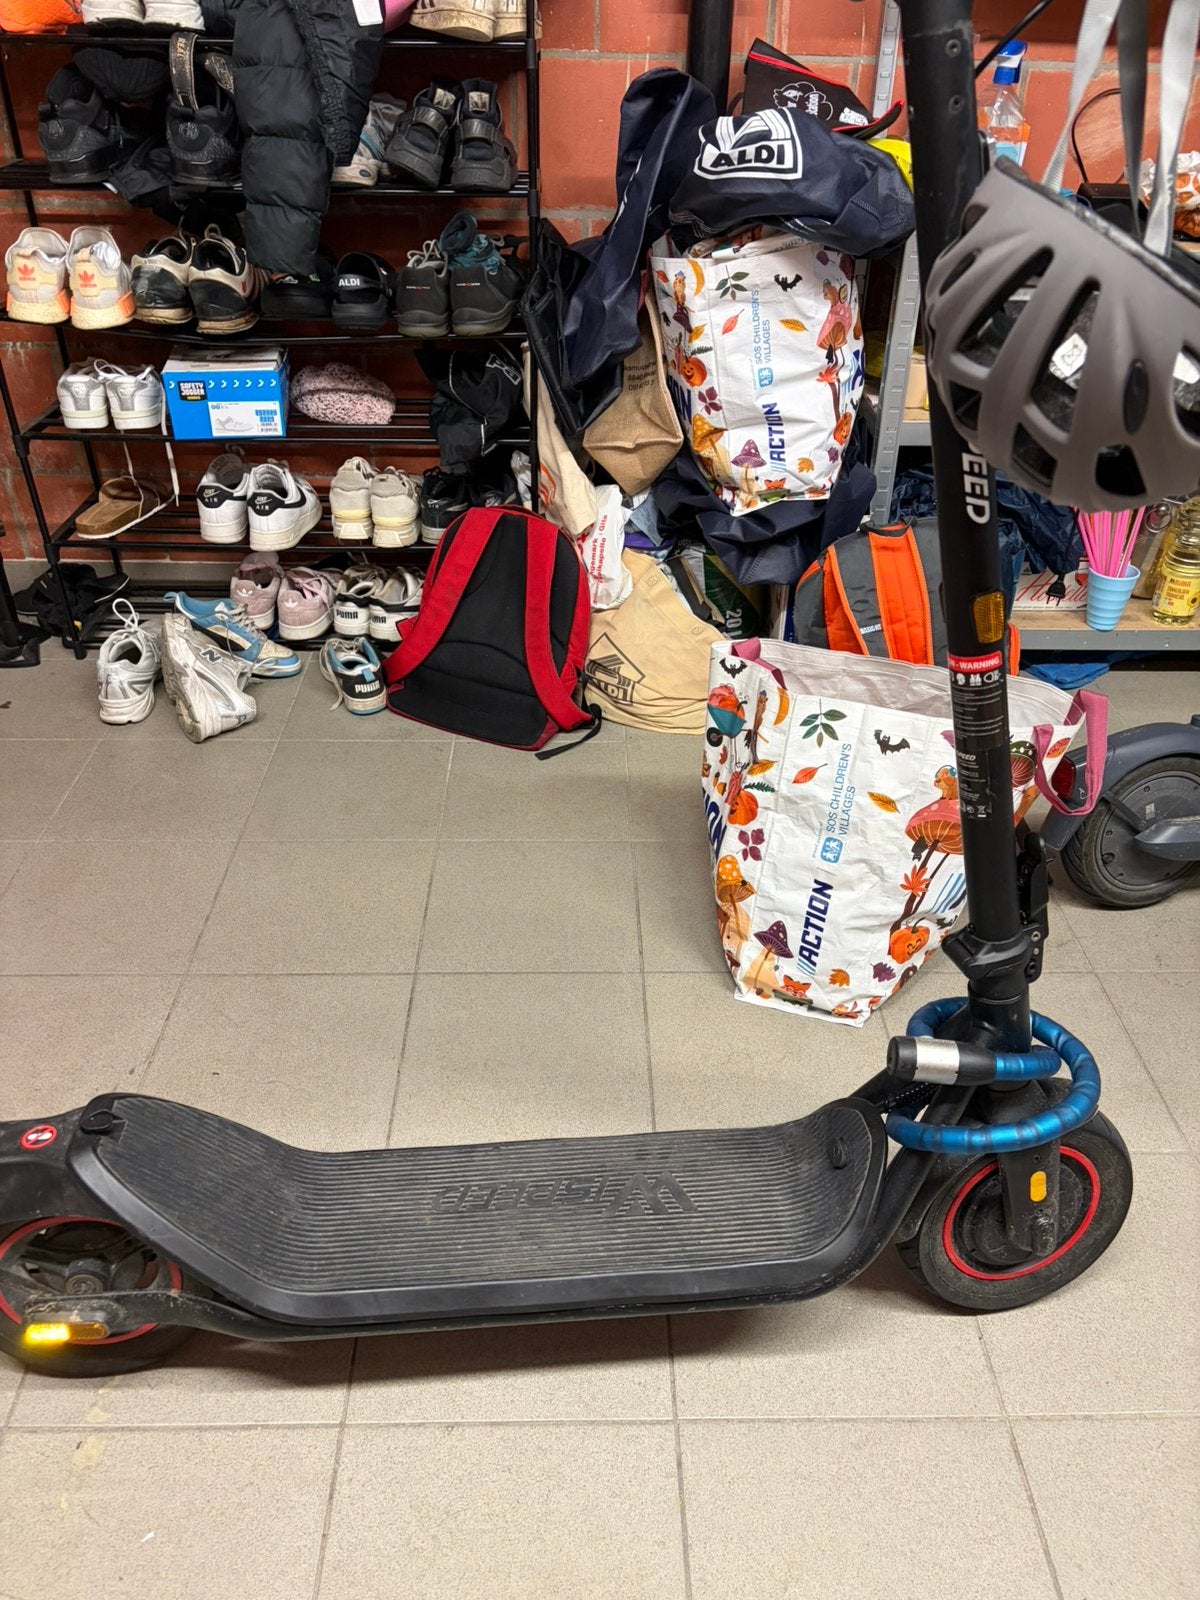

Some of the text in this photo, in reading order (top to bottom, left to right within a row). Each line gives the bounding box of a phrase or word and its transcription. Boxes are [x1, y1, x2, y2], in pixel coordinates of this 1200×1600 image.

[710, 144, 785, 168] ALDI
[338, 278, 360, 286] ALDI
[751, 289, 761, 343] CHILDREN'S
[753, 345, 763, 365] SOS
[762, 319, 772, 363] VILLAGES
[762, 402, 786, 462] ACTION
[961, 441, 991, 525] EED
[336, 609, 359, 620] PUMA
[959, 656, 1000, 670] WARNING
[354, 680, 381, 694] PUMA
[825, 743, 852, 834] SOS CHILDREN'S
[838, 785, 856, 836] VILLAGES
[798, 878, 834, 968] ACTION
